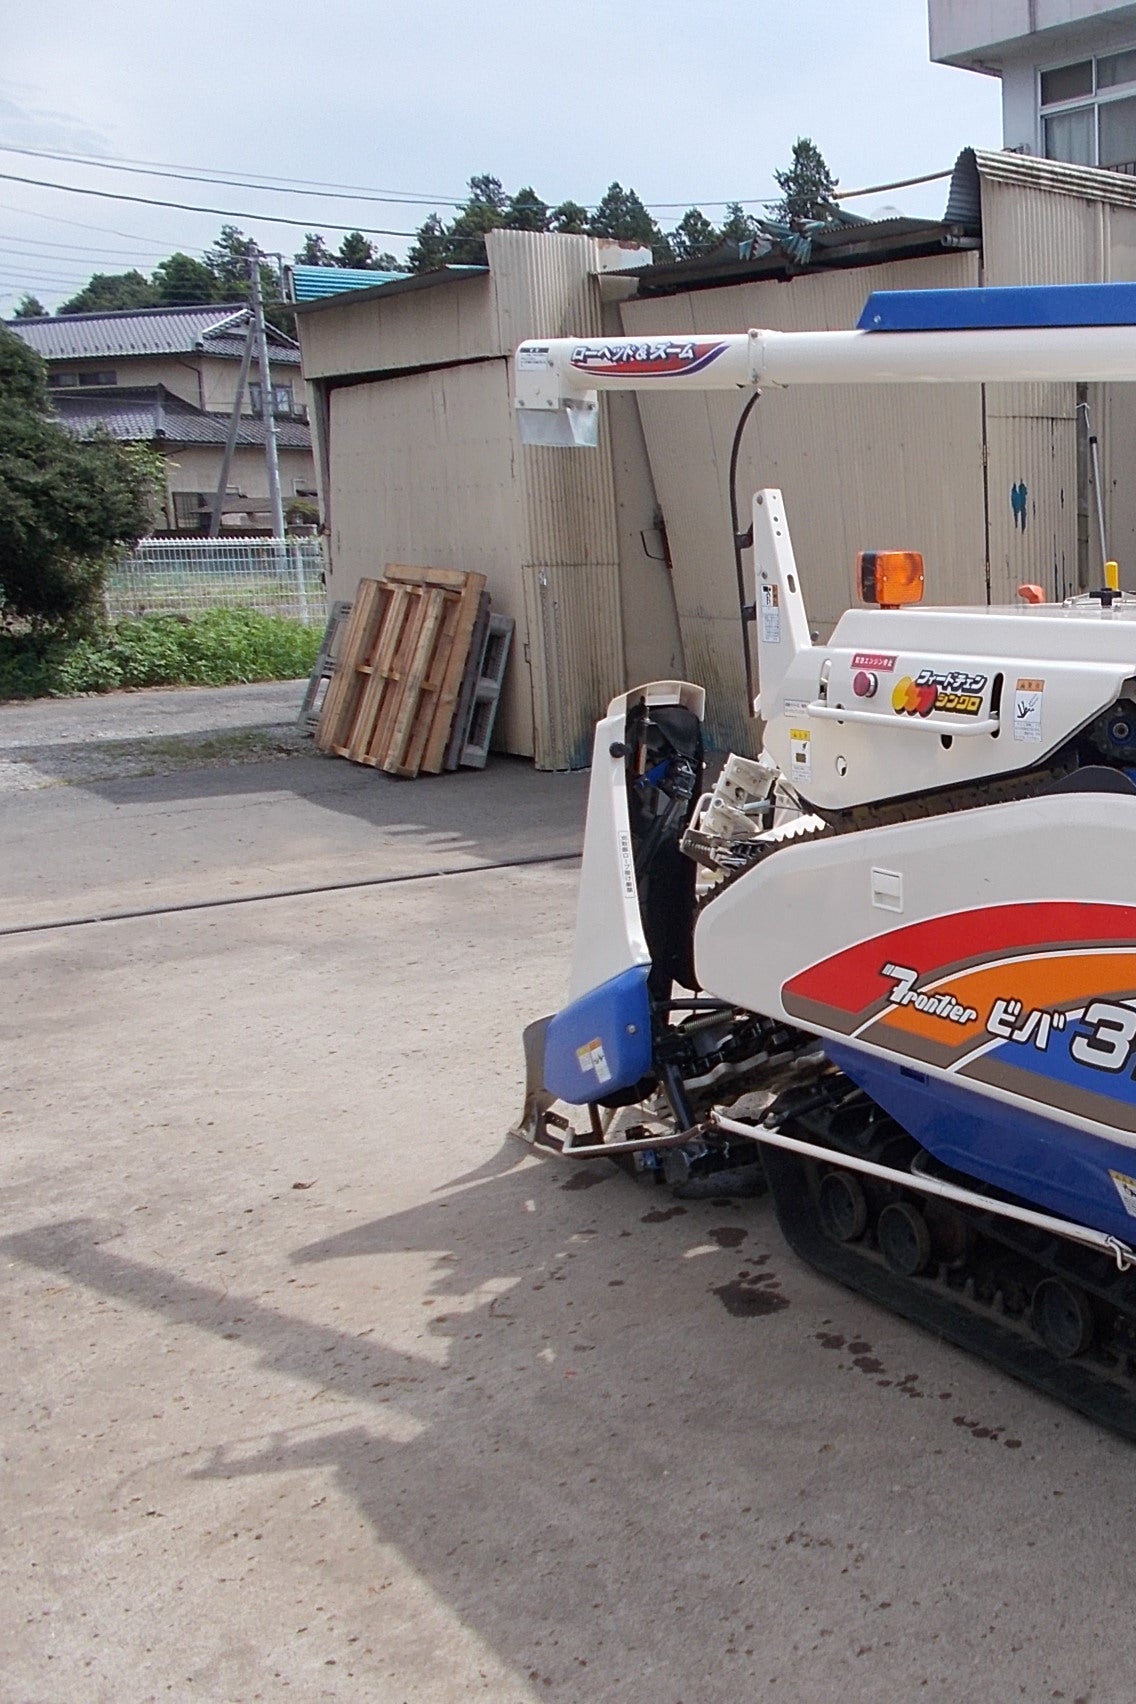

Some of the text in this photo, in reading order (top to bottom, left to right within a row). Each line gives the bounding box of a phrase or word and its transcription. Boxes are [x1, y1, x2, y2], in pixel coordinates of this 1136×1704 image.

[916, 670, 987, 693] フィードチェン
[936, 692, 983, 714] シンクロ
[882, 963, 977, 1024] Frontier
[986, 999, 1067, 1050] ビバ
